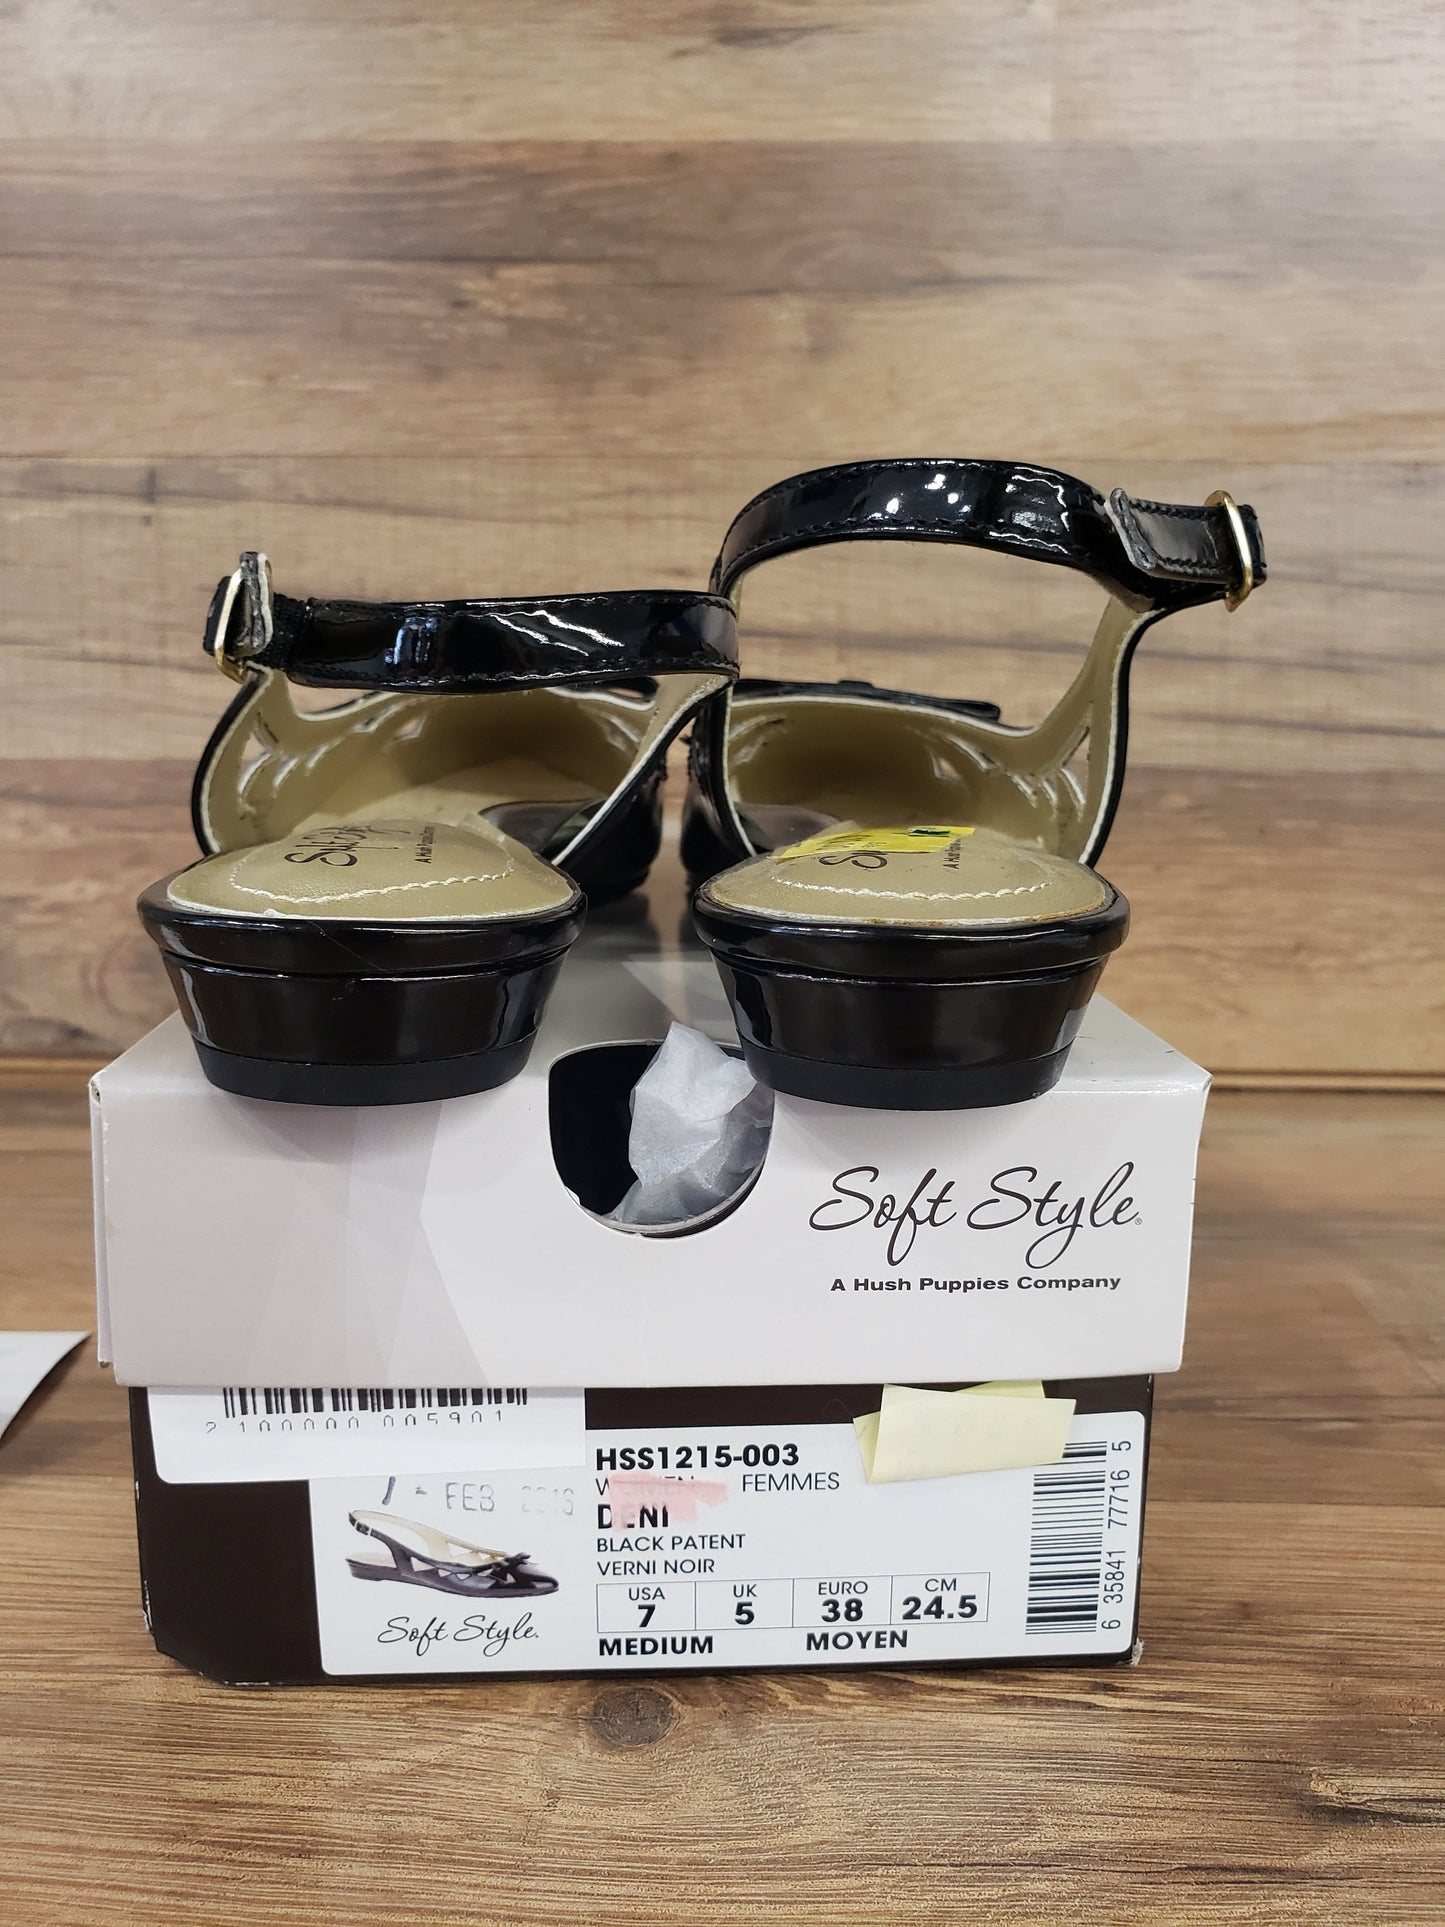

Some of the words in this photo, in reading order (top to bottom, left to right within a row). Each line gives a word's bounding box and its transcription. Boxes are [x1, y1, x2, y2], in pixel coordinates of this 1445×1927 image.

[809, 1166, 957, 1266] Soft
[831, 1279, 846, 1291] A
[853, 1278, 911, 1291] Hush
[919, 1277, 1010, 1293] Puppies
[1017, 1276, 1121, 1291] Company
[596, 1443, 800, 1471] HSS1215-003
[1111, 1440, 1131, 1451] 5
[741, 1472, 840, 1492] FEMMES
[445, 1482, 495, 1513] FEB
[1107, 1469, 1130, 1529] 77716
[597, 1502, 669, 1529] DNI
[596, 1536, 664, 1553] BLACK
[671, 1533, 746, 1550] PATENT
[596, 1560, 657, 1576] VERNI
[664, 1558, 715, 1574] NOIR
[1103, 1550, 1127, 1603] 35841
[628, 1586, 665, 1600] USA
[733, 1584, 757, 1598] UK
[818, 1581, 868, 1595] EURO
[924, 1578, 957, 1592] CM
[637, 1604, 656, 1628] 7
[734, 1602, 755, 1626] 5
[821, 1599, 863, 1623] 38
[902, 1595, 978, 1620] 24.5
[1101, 1619, 1121, 1630] 6
[377, 1616, 449, 1657] Soft
[599, 1636, 714, 1656] MEDIUM
[806, 1630, 908, 1651] MOYEN
